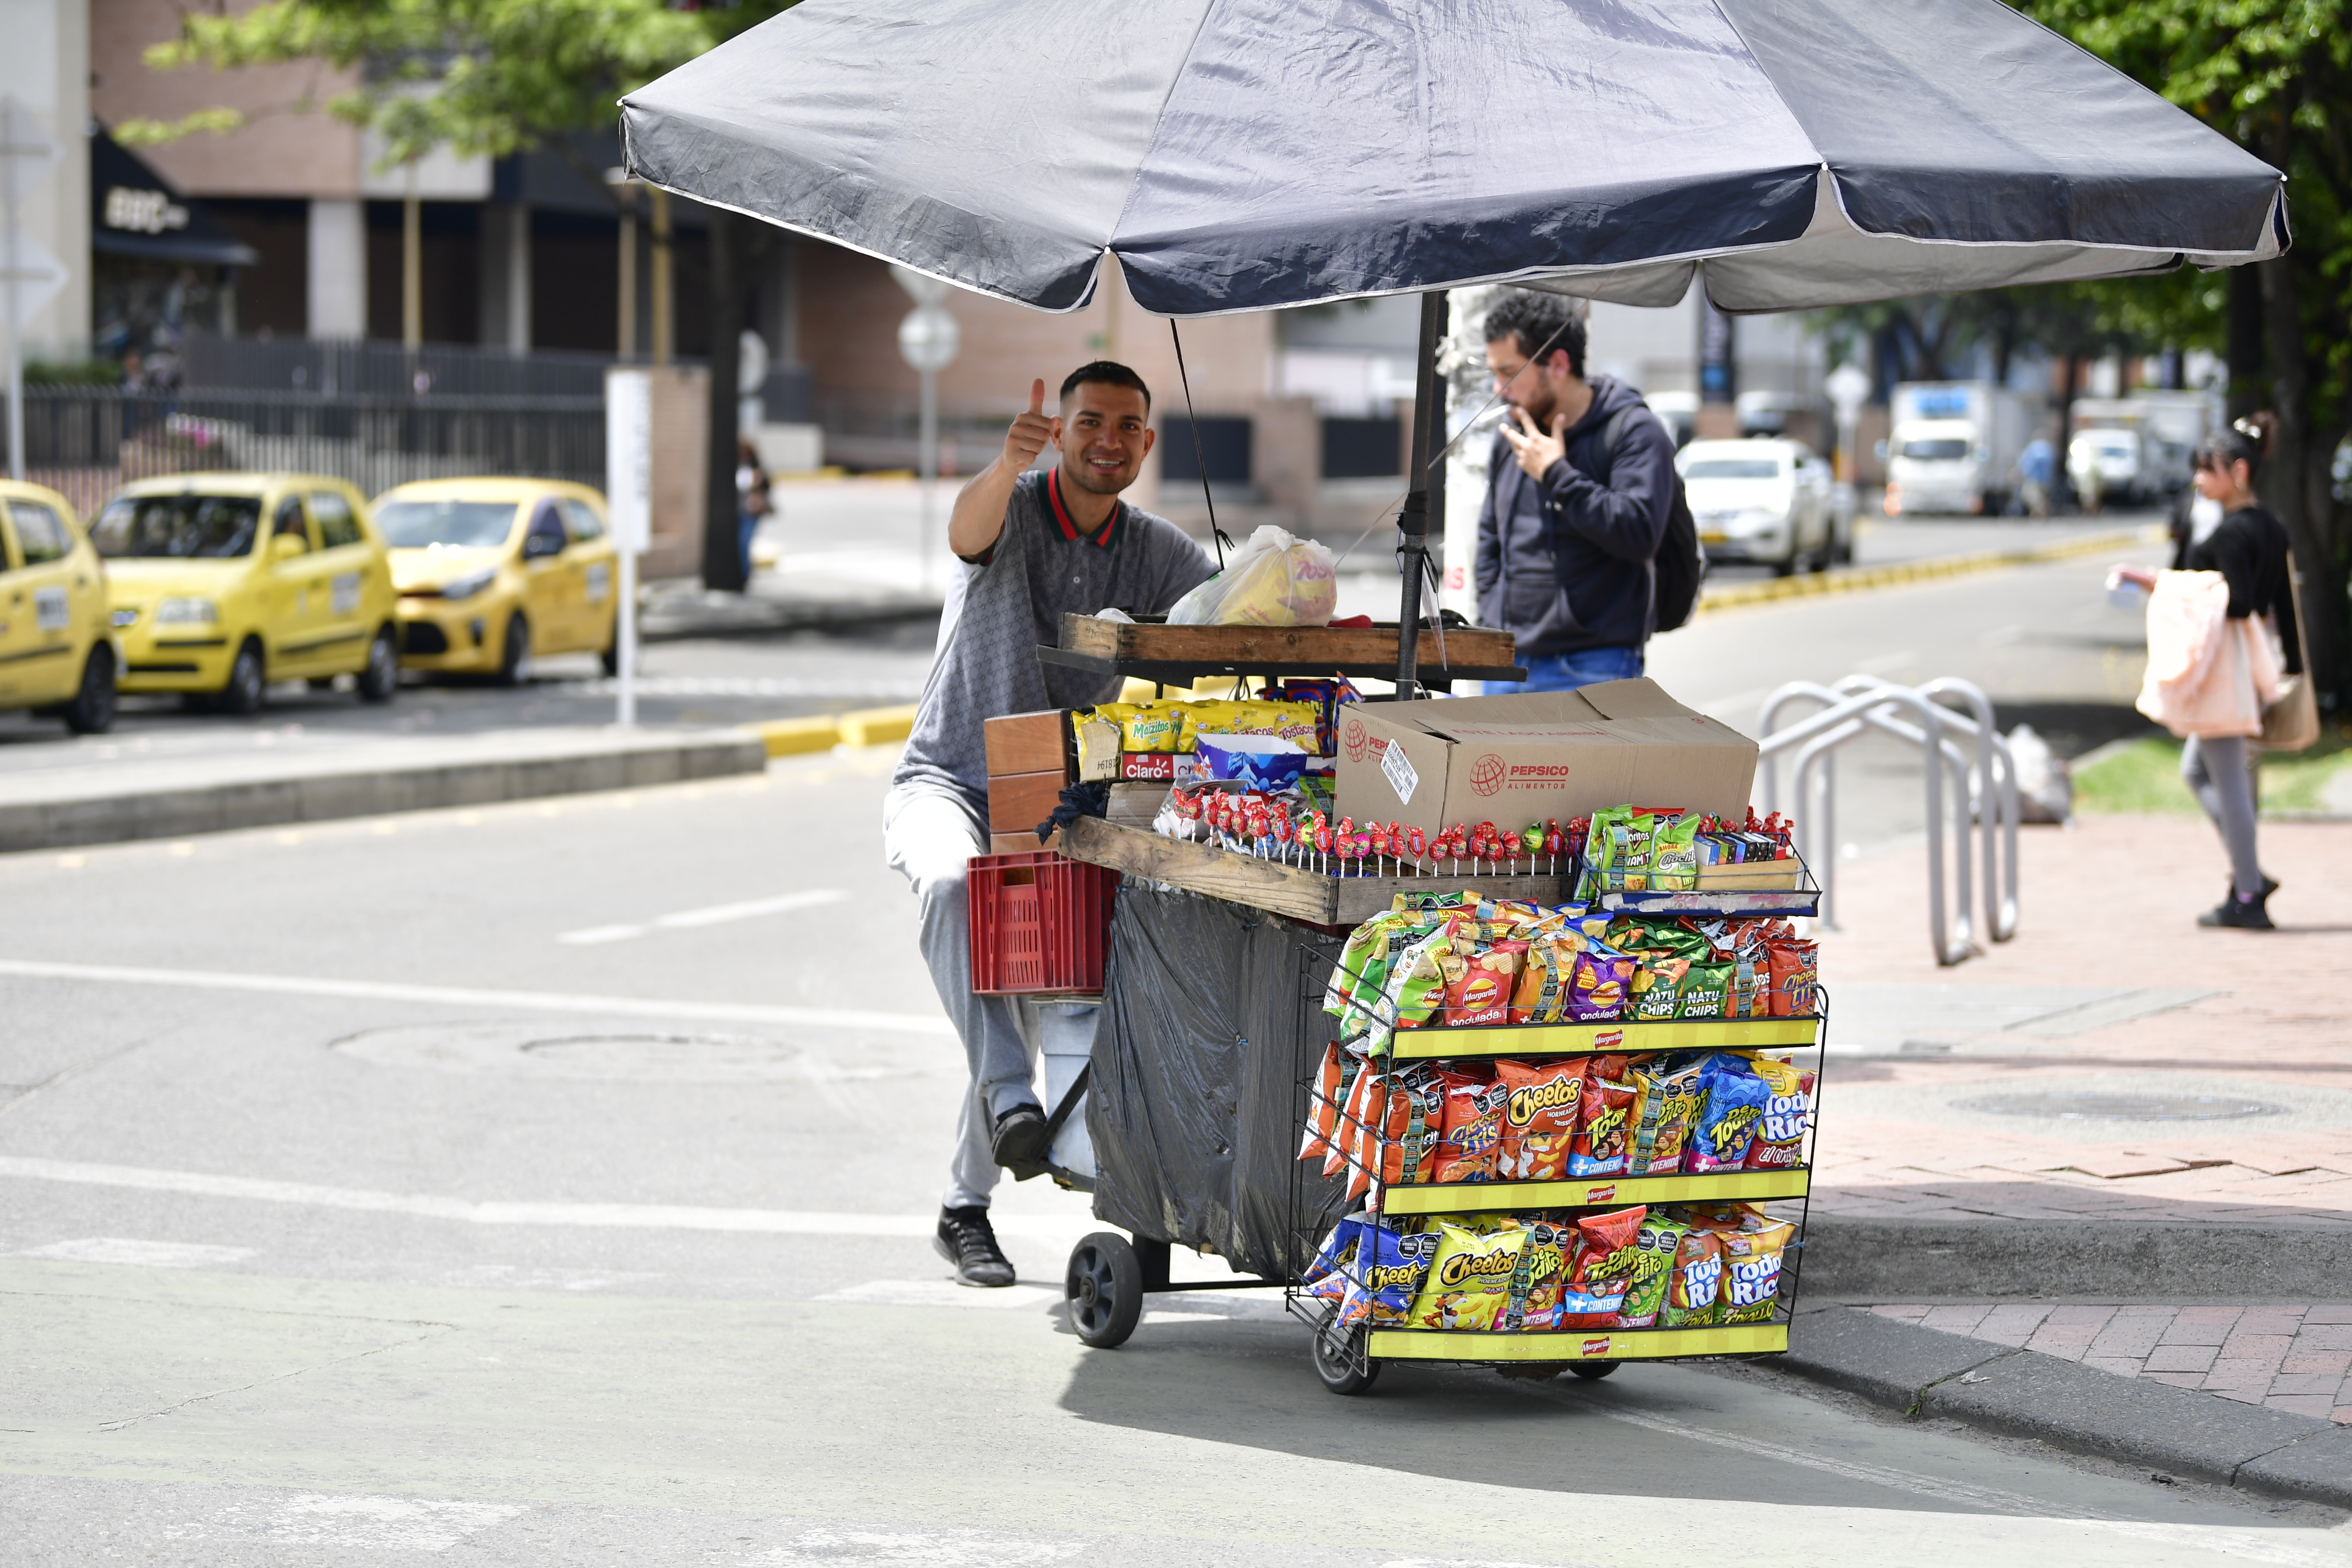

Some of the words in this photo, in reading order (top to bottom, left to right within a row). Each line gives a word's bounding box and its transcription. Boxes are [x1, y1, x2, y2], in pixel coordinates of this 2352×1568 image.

[1132, 719, 1169, 739] Maizitos
[1279, 725, 1315, 740] Tostacos
[1127, 763, 1162, 778] Claro
[1510, 765, 1569, 776] PEPSICO
[1629, 831, 1650, 842] oritos
[1658, 852, 1696, 870] Choclit
[1464, 988, 1497, 1002] Margarita
[1643, 990, 1674, 1002] NATU
[1688, 991, 1719, 1004] NATU
[1639, 1004, 1674, 1015] CHIPS
[1685, 1004, 1718, 1017] CHIPS
[1594, 1033, 1622, 1045] Margarita
[1508, 1077, 1581, 1126] Cheetos
[1764, 1090, 1809, 1116] Todo
[1546, 1104, 1578, 1118] HORNEADOS
[1765, 1112, 1808, 1141] Ric
[1617, 1141, 1625, 1155] BBQ
[1734, 1141, 1750, 1158] NATURAL
[1759, 1146, 1776, 1162] El
[1648, 1157, 1679, 1172] NTENIDO
[1587, 1187, 1615, 1200] Margarita
[1442, 1248, 1516, 1285] Cheetos
[1684, 1252, 1721, 1285] Tod
[1729, 1254, 1781, 1282] Todo
[1366, 1263, 1423, 1292] Cheet
[1613, 1281, 1624, 1293] BBQ
[1732, 1278, 1777, 1305] Ric
[1618, 1315, 1652, 1328] ONTENIDO
[1582, 1339, 1610, 1352] Margarita
